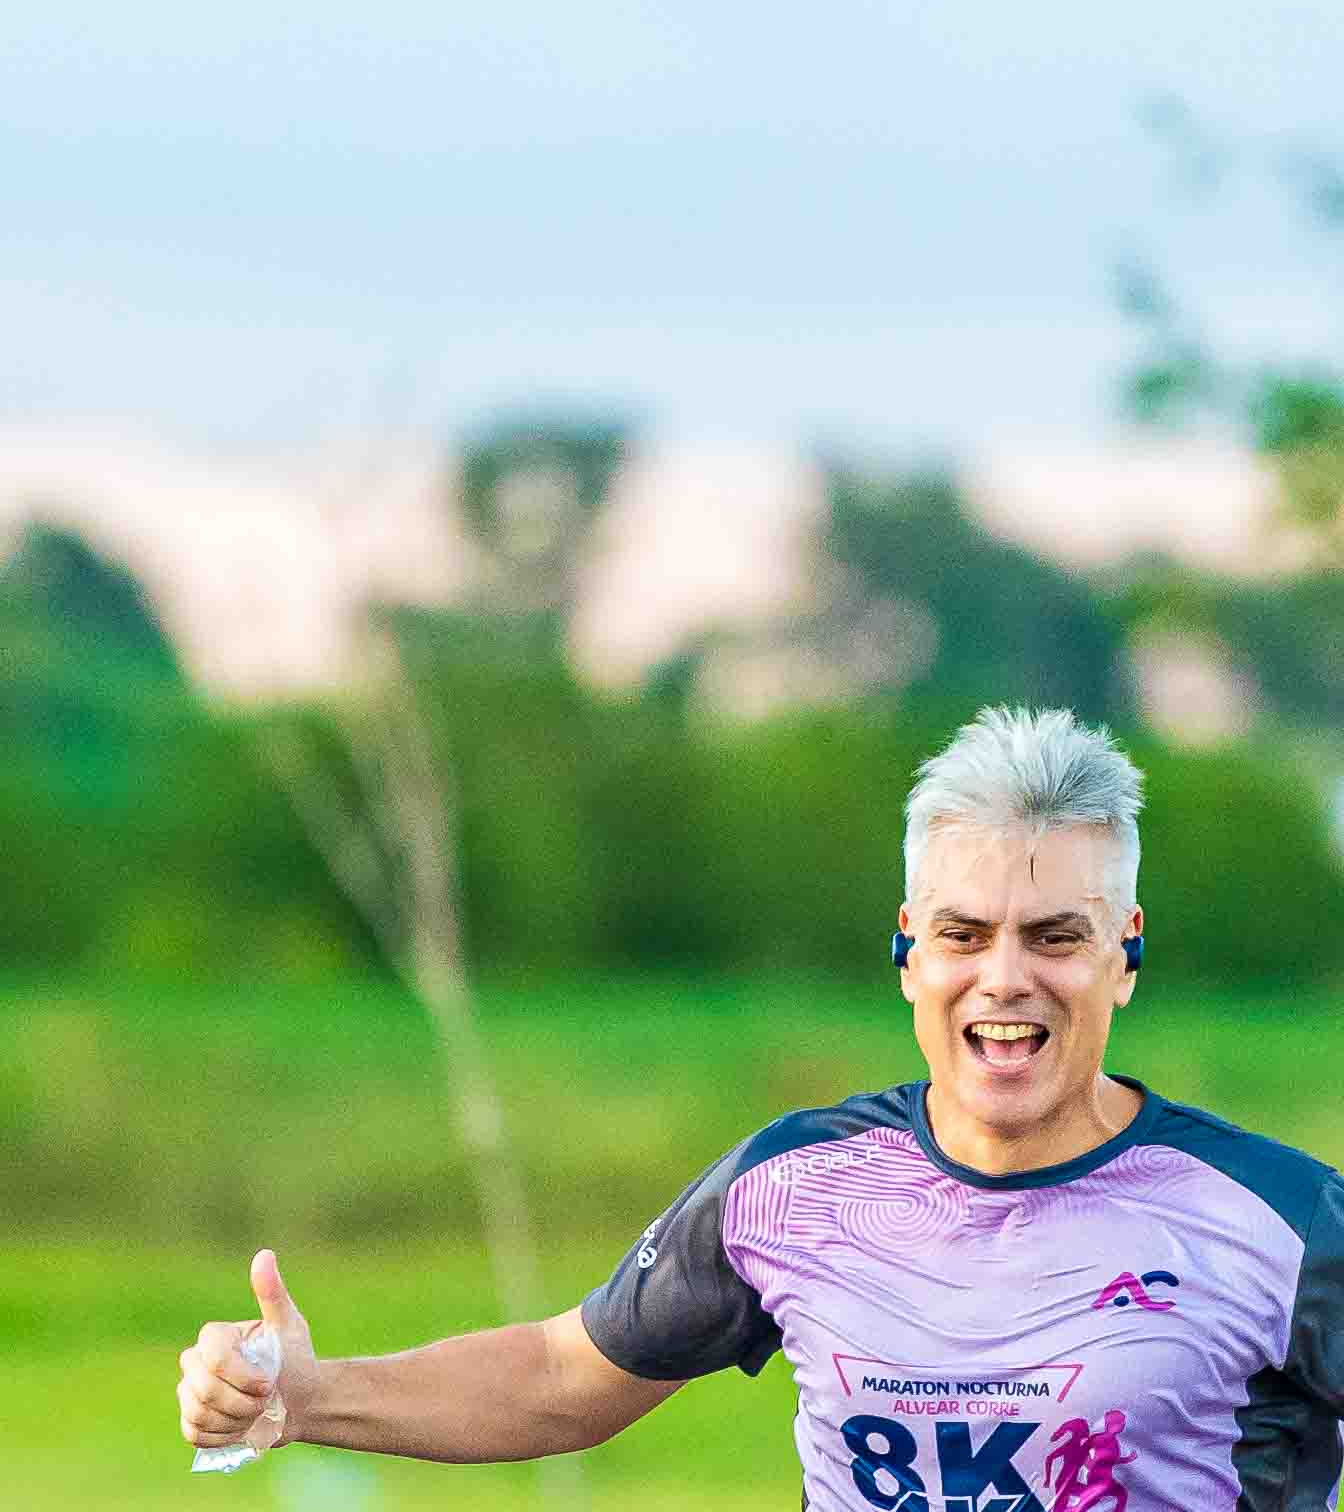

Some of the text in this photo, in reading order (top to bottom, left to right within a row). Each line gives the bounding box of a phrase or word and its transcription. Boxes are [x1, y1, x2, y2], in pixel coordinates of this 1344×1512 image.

[861, 1375, 1051, 1397] MARATON NOCTURNA
[893, 1399, 1020, 1417] ALVEAR CORRE
